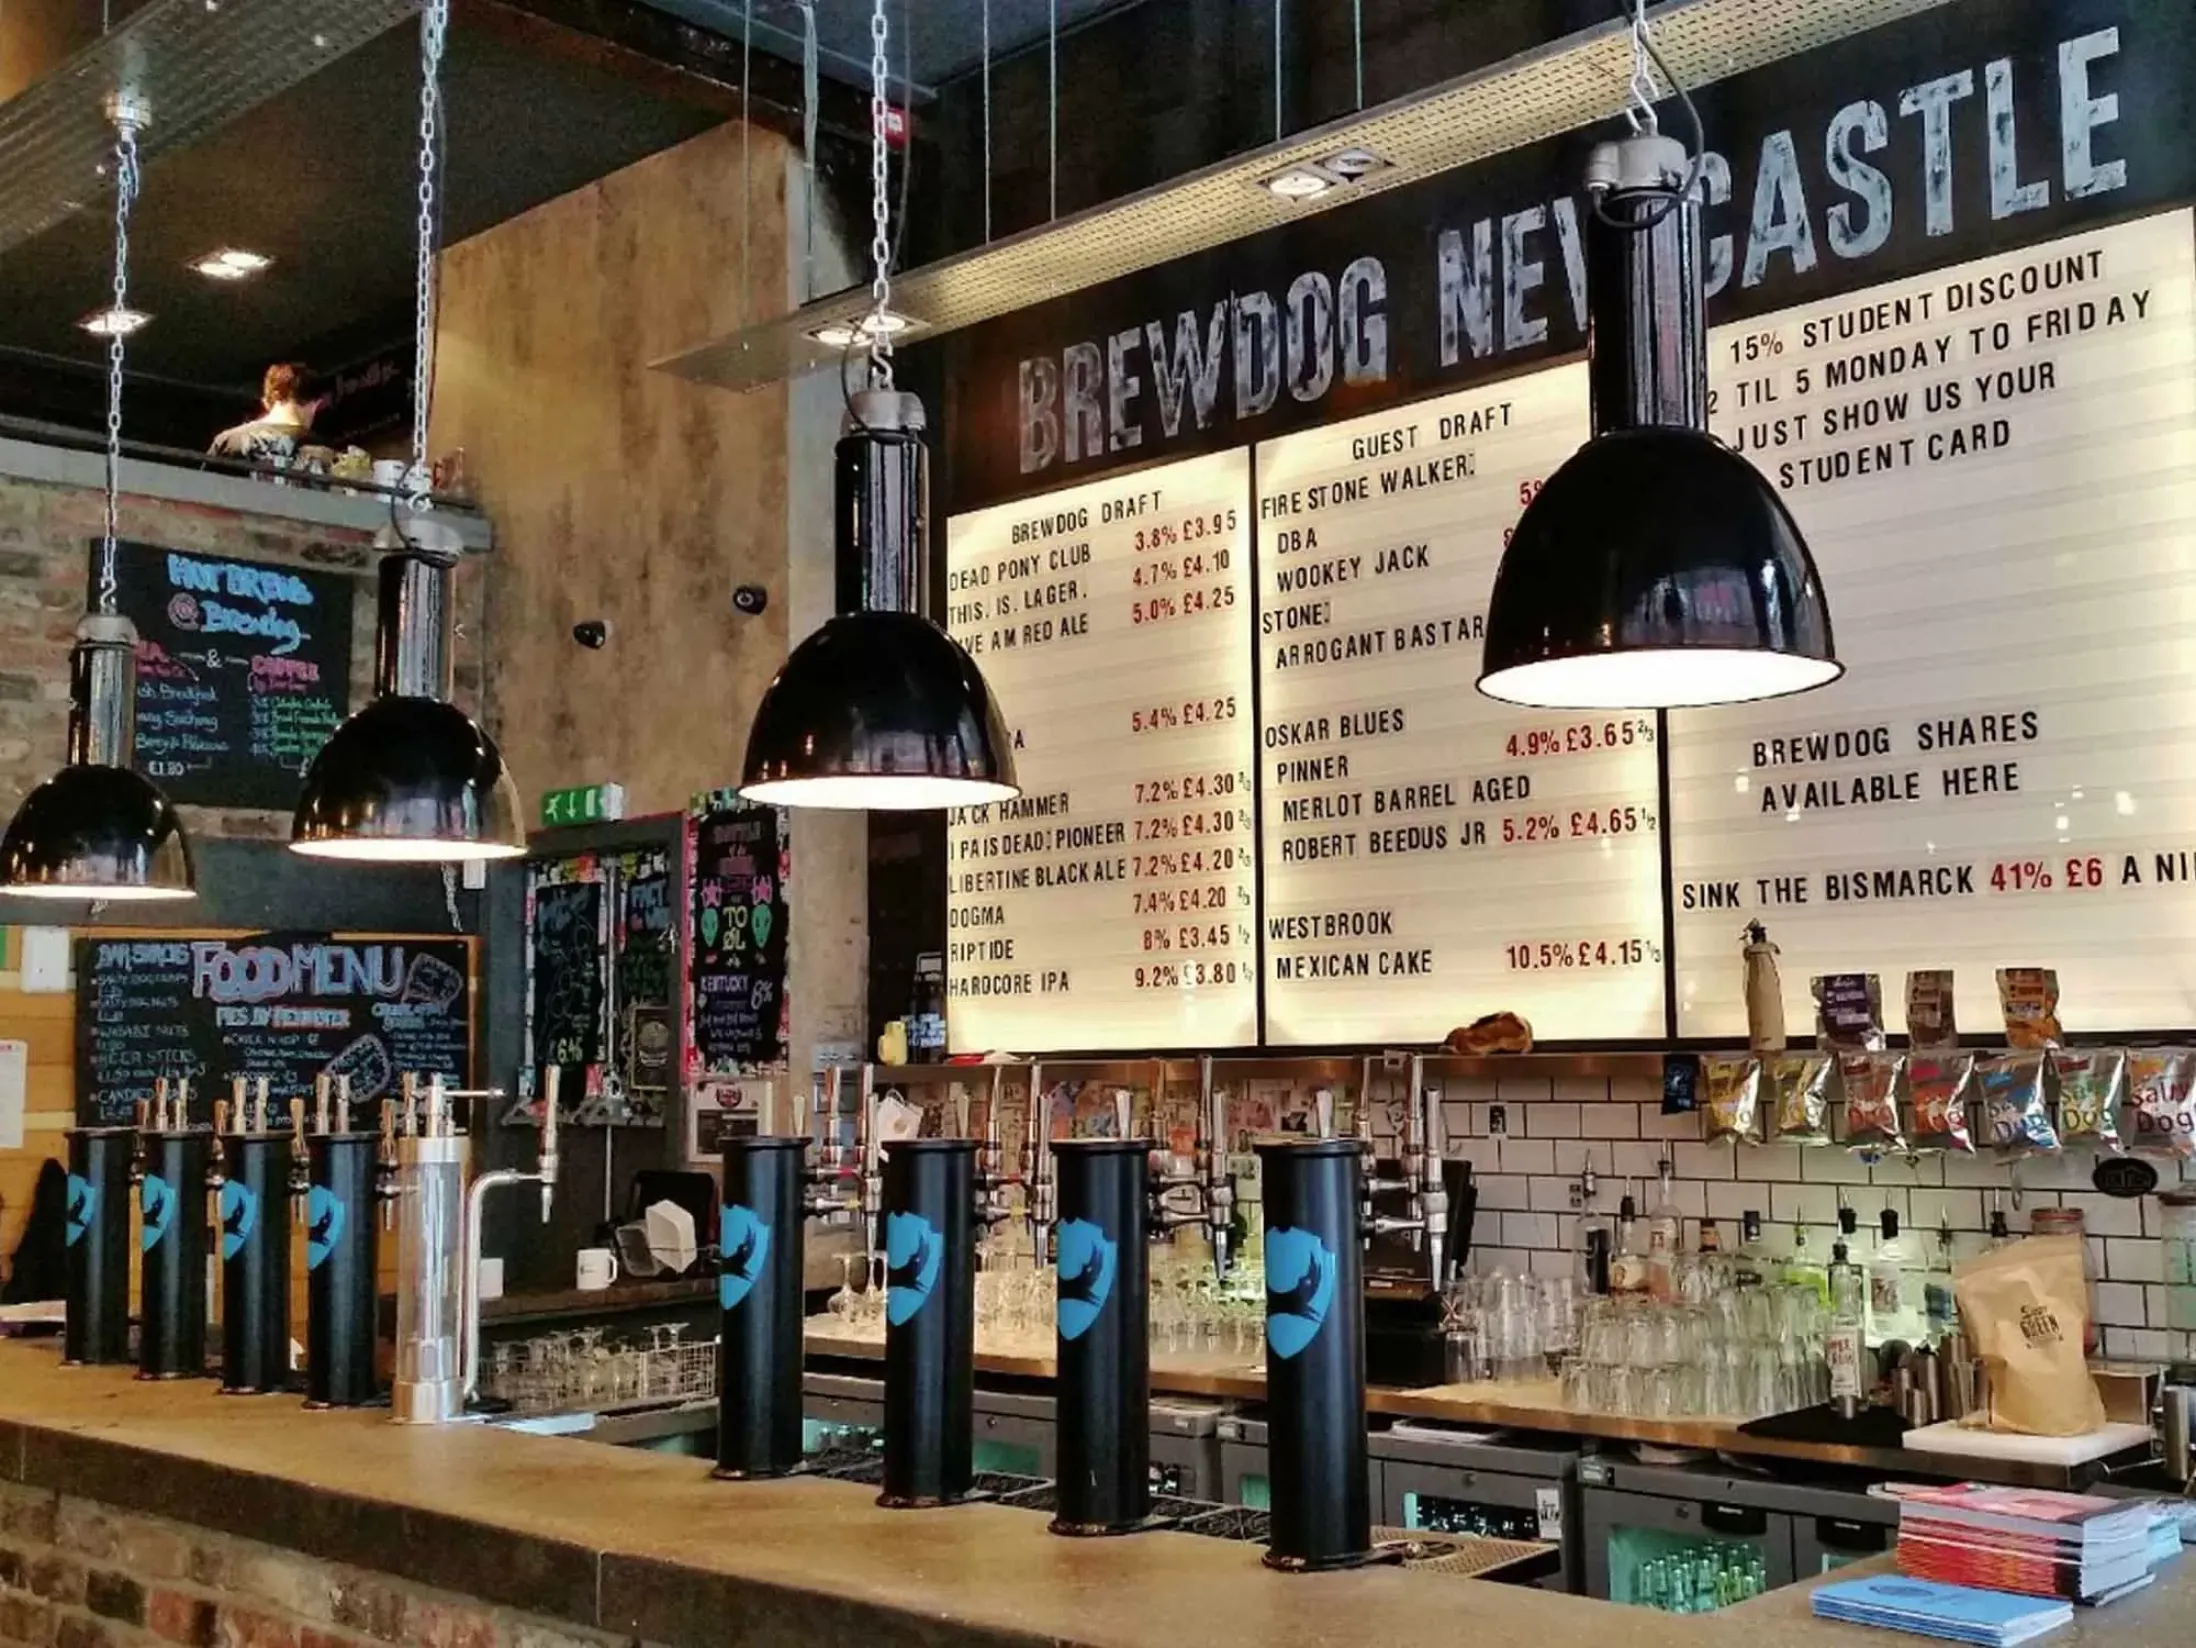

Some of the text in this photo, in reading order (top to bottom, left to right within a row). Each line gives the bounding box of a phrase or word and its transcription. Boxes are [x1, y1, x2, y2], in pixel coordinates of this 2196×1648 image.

[1018, 25, 2128, 475] BREWDOG NECASTLE
[1731, 250, 2104, 366] 15% STUDENT DISCOUNT
[1736, 376, 1778, 409] TIL
[1796, 368, 1810, 394] 5
[1826, 334, 1952, 390] MONDAY
[1969, 322, 2010, 356] TO
[2028, 289, 2152, 344] FRIDAY
[1353, 402, 1512, 461] GUEST DRAFT
[1733, 360, 2057, 454] JUST SHOW US YOUR
[1381, 451, 1476, 495] WALKER:
[1779, 419, 2012, 490] STUDENT CARD
[1012, 490, 1163, 545] BREWDOG DRAFT
[1277, 527, 1318, 555] DBA
[950, 509, 1237, 591] DEAD PONY CLUB 3.8% £3.95
[1277, 544, 1429, 593] WOOKEY JACK
[949, 549, 1231, 626] THIS. IS. LAGER. 4.7% £4.10
[992, 627, 1017, 651] AM
[1022, 619, 1053, 645] RED
[1060, 613, 1089, 638] ALE
[1132, 597, 1176, 625] 5.0%
[1183, 585, 1235, 616] £4.25
[1262, 600, 1332, 635] STONE:
[1276, 615, 1485, 669] ARROGANT BASTAR
[1132, 697, 1237, 733] 5.4% £4.25
[1265, 708, 1405, 750] OSKAR BLUES
[1753, 711, 2040, 768] BREWDOG SHARES
[1277, 754, 1349, 784] PINNER
[1505, 730, 1561, 758] 4.9%
[1566, 721, 1635, 752] £3.65
[949, 804, 990, 827] JACK
[1000, 792, 1070, 822] HAMMER
[1134, 781, 1179, 804] 7.2%
[1183, 773, 1235, 799] £4.30
[1282, 774, 1531, 823] MERLOT BARREL AGED
[1761, 762, 2020, 814] AVAILABLE HERE
[982, 836, 998, 857] IS
[1002, 829, 1051, 855] DEAD:
[1056, 822, 1126, 849] PIONEER
[1134, 817, 1178, 842] 7.2%
[1183, 809, 1235, 836] £4.30
[1282, 834, 1358, 863] ROBERT
[1370, 825, 1448, 855] BEEDUS
[1460, 820, 1487, 847] JR
[1502, 815, 1560, 844] 5.2%
[1570, 807, 1638, 838] £4.65
[949, 867, 1030, 894] LIBERTINE
[1035, 862, 1089, 888] BLACK
[1094, 858, 1126, 883] ALE
[1133, 855, 1178, 878] 7.2%
[1181, 847, 1234, 873] £4.20
[1682, 851, 2196, 910] SINK THE BISMARCK 41% £6 A NI
[722, 906, 748, 927] TO
[950, 905, 1005, 928] DOGMA
[1133, 891, 1175, 914] 7.4%
[1179, 886, 1227, 911] £4.20
[1269, 911, 1394, 941] WESTBROOK
[950, 939, 1014, 962] RIPTIDE
[1143, 929, 1171, 951] 8%
[1179, 924, 1231, 949] £3.45
[1276, 951, 1370, 980] MEXICAN
[1379, 949, 1433, 976] CAKE
[1506, 944, 1574, 970] 10.5%
[1578, 938, 1643, 967] £4.15
[191, 941, 292, 1002] FOOD
[291, 943, 404, 998] MENU
[949, 970, 1032, 997] HARDCORE
[1041, 971, 1070, 992] IPA
[1134, 964, 1179, 988] 9.2%
[1183, 962, 1236, 985] £3.80
[2137, 1110, 2195, 1135] Dog
